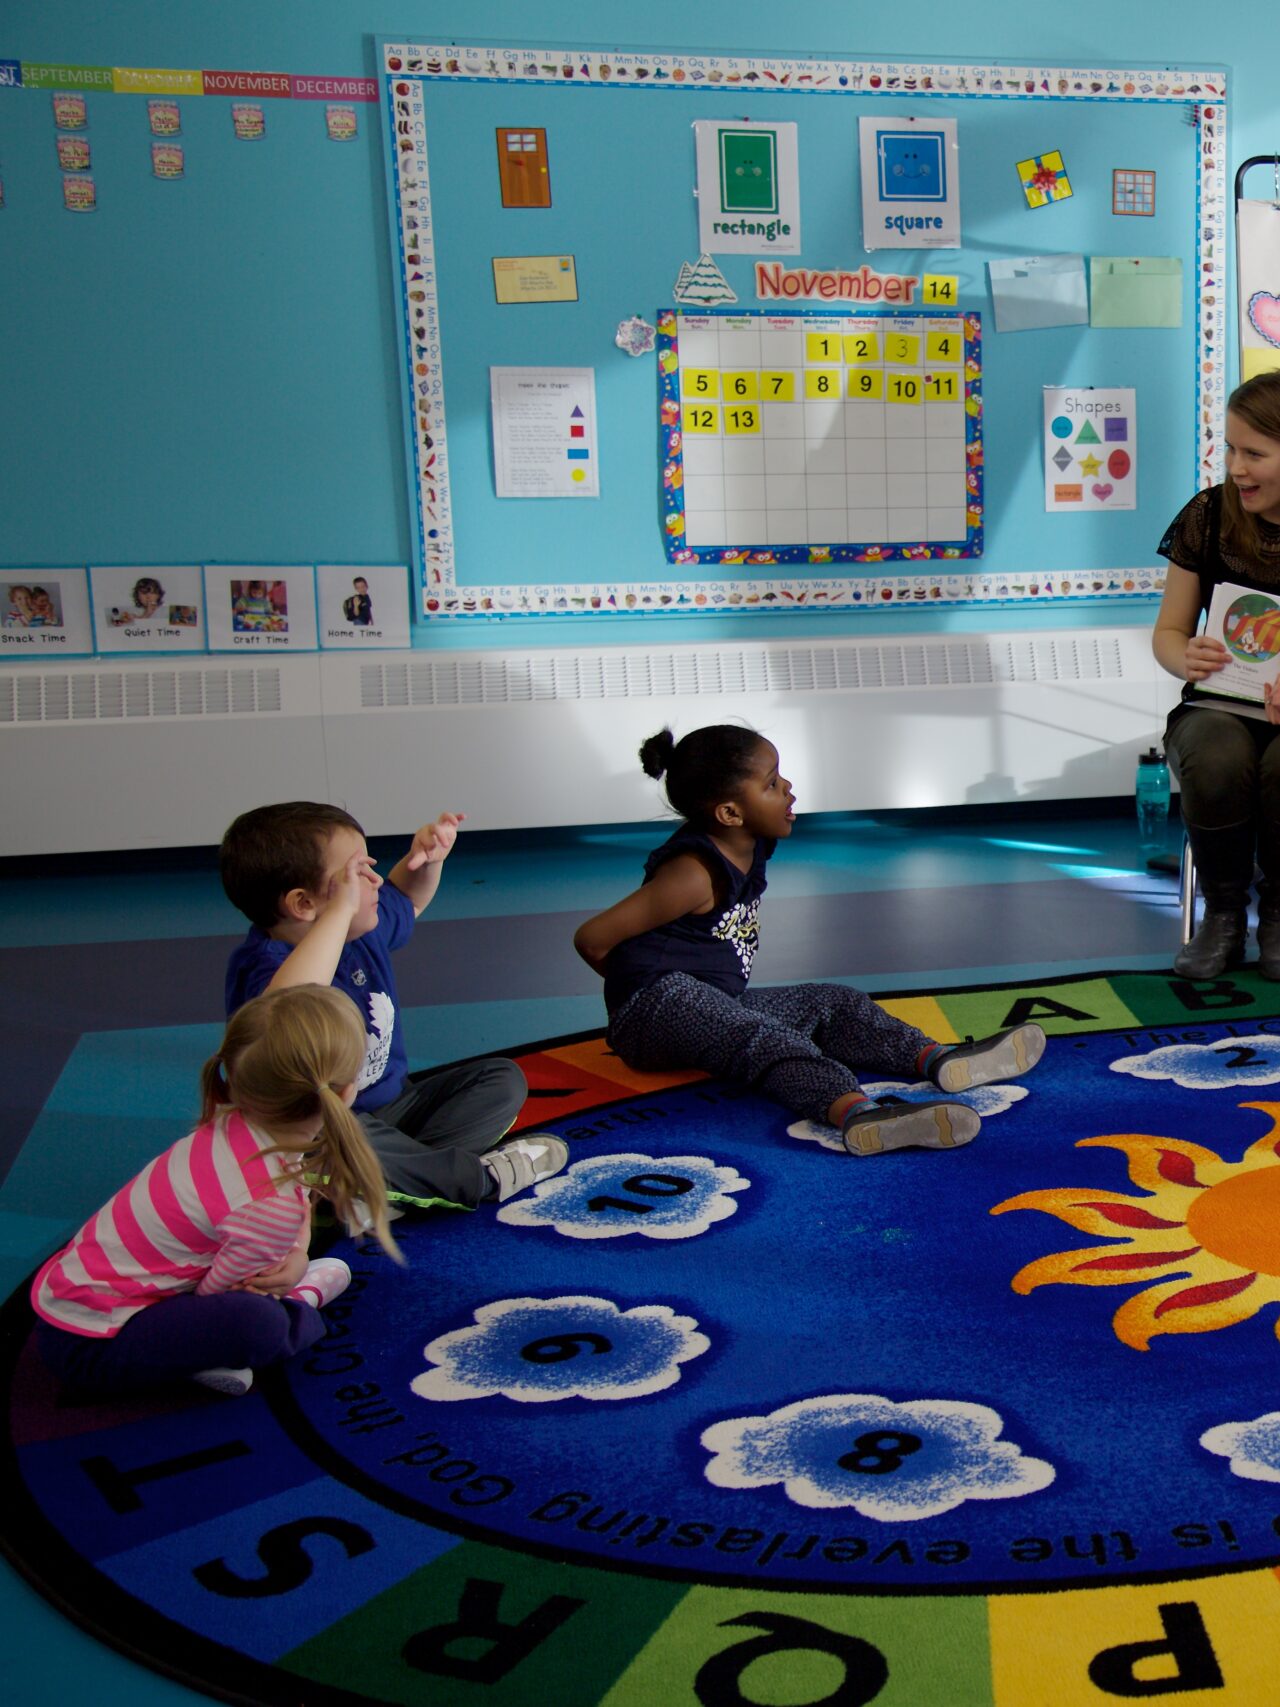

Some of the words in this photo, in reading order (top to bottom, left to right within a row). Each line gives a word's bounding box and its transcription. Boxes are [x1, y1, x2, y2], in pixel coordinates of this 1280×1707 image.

[22, 67, 112, 84] SEPTEMBER
[204, 75, 290, 91] NOVEMBER
[296, 80, 376, 96] DECEMBER
[713, 219, 790, 241] rectangle
[884, 214, 944, 236] square
[757, 265, 916, 300] November
[930, 282, 952, 298] 14
[684, 317, 709, 325] Sunday
[725, 317, 752, 325] Monday
[767, 317, 794, 326] Tuesday
[803, 318, 840, 326] Wednesday
[847, 318, 879, 327] Thursday
[894, 318, 914, 327] Friday
[928, 319, 959, 327] Saturday
[820, 340, 828, 355] 1
[856, 340, 868, 356] 2
[896, 339, 908, 358] 3
[938, 340, 950, 355] 4
[696, 375, 708, 391] 5
[735, 379, 746, 395] 6
[771, 378, 783, 394] 7
[817, 376, 829, 392] 8
[860, 375, 872, 391] 9
[894, 381, 916, 397] 10
[932, 379, 953, 394] 11
[691, 411, 713, 427] 12
[731, 411, 754, 427] 13
[1065, 398, 1121, 418] Shapes
[2, 634, 34, 644] Snack
[40, 634, 66, 643] Time
[124, 628, 151, 638] Quiet
[157, 628, 181, 637] Time
[233, 636, 261, 644] Craft
[267, 636, 289, 644] Time
[328, 630, 352, 638] Home
[358, 629, 382, 638] Time
[1172, 978, 1255, 1010] B
[1000, 995, 1098, 1029] A
[1114, 1028, 1214, 1048] The
[1214, 1046, 1268, 1068] 2
[564, 1102, 684, 1140] arth.
[587, 1173, 694, 1214] 10
[334, 1382, 405, 1435] the
[837, 1428, 922, 1474] 8
[79, 1438, 254, 1515] T
[383, 1432, 516, 1506] God,
[528, 1491, 970, 1566] everlasting
[1170, 1520, 1238, 1552] is
[192, 1516, 376, 1600] S
[1009, 1528, 1139, 1566] the
[400, 1578, 587, 1686] R
[693, 1611, 890, 1706] Q
[1088, 1602, 1225, 1697] P
